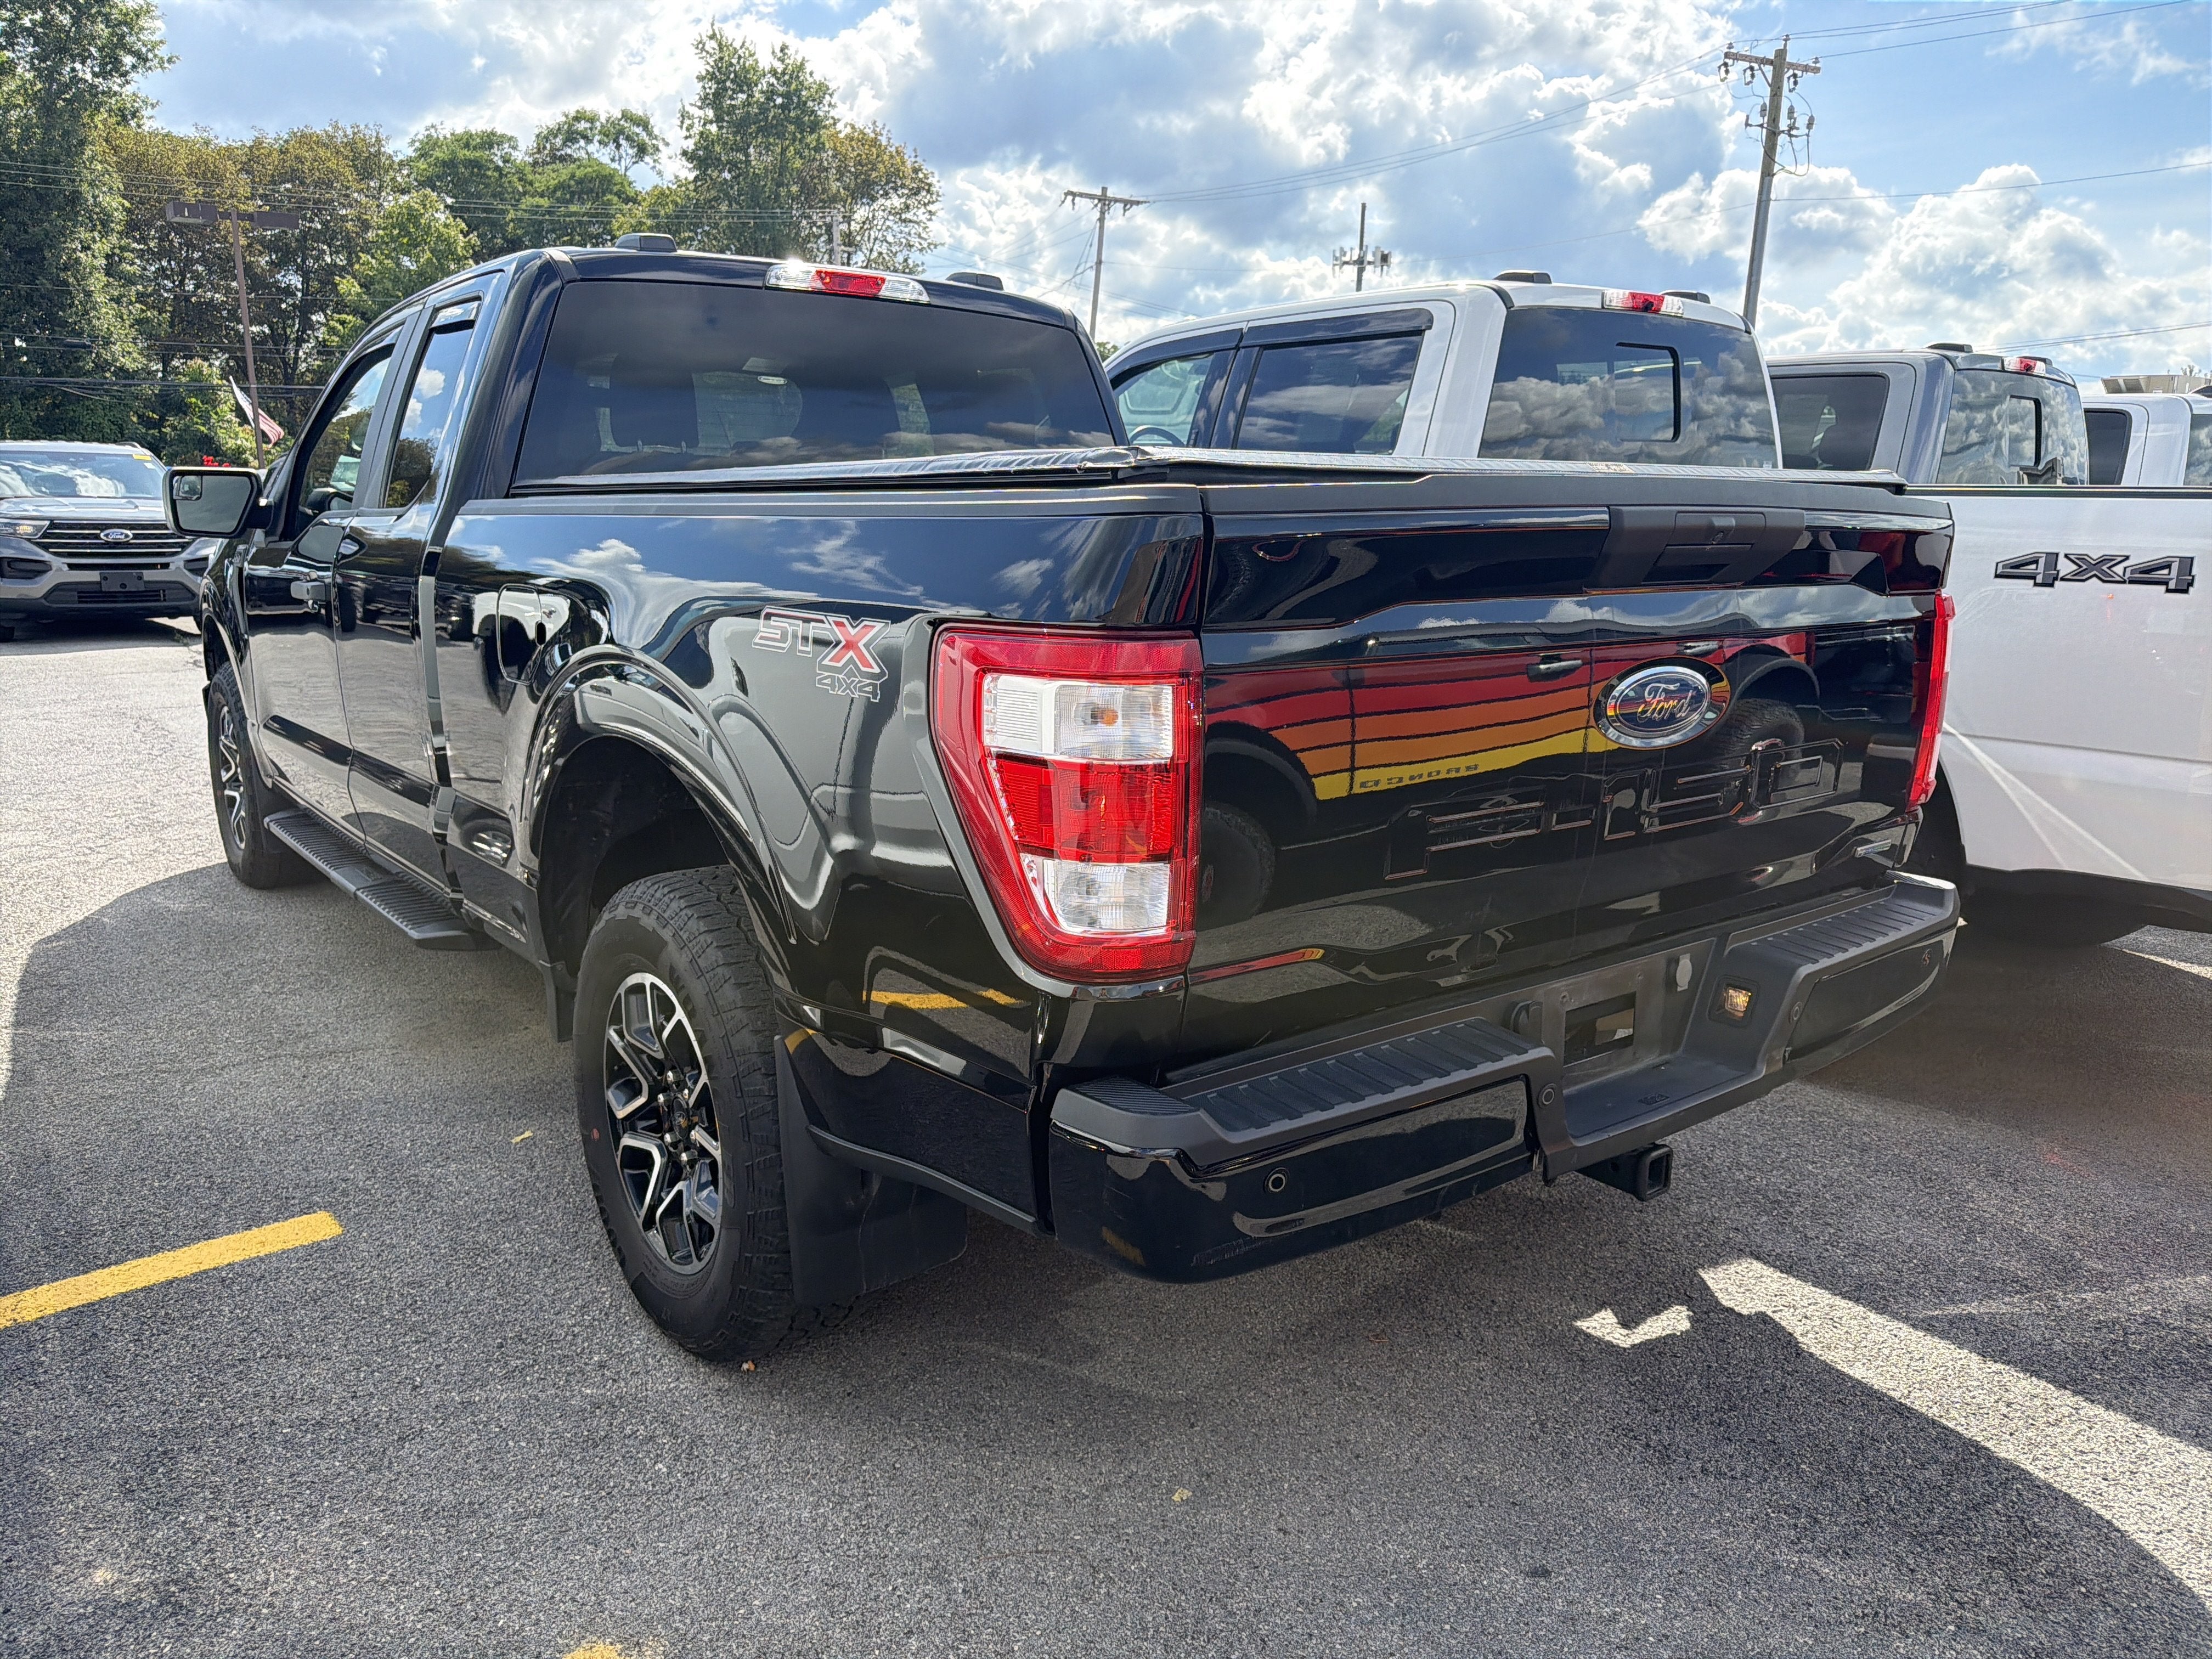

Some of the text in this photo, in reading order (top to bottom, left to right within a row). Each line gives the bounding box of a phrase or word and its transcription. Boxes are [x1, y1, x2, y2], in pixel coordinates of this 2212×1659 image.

[752, 606, 890, 682] STX
[1637, 683, 1694, 724] Ford
[1384, 738, 1844, 881] F-150
